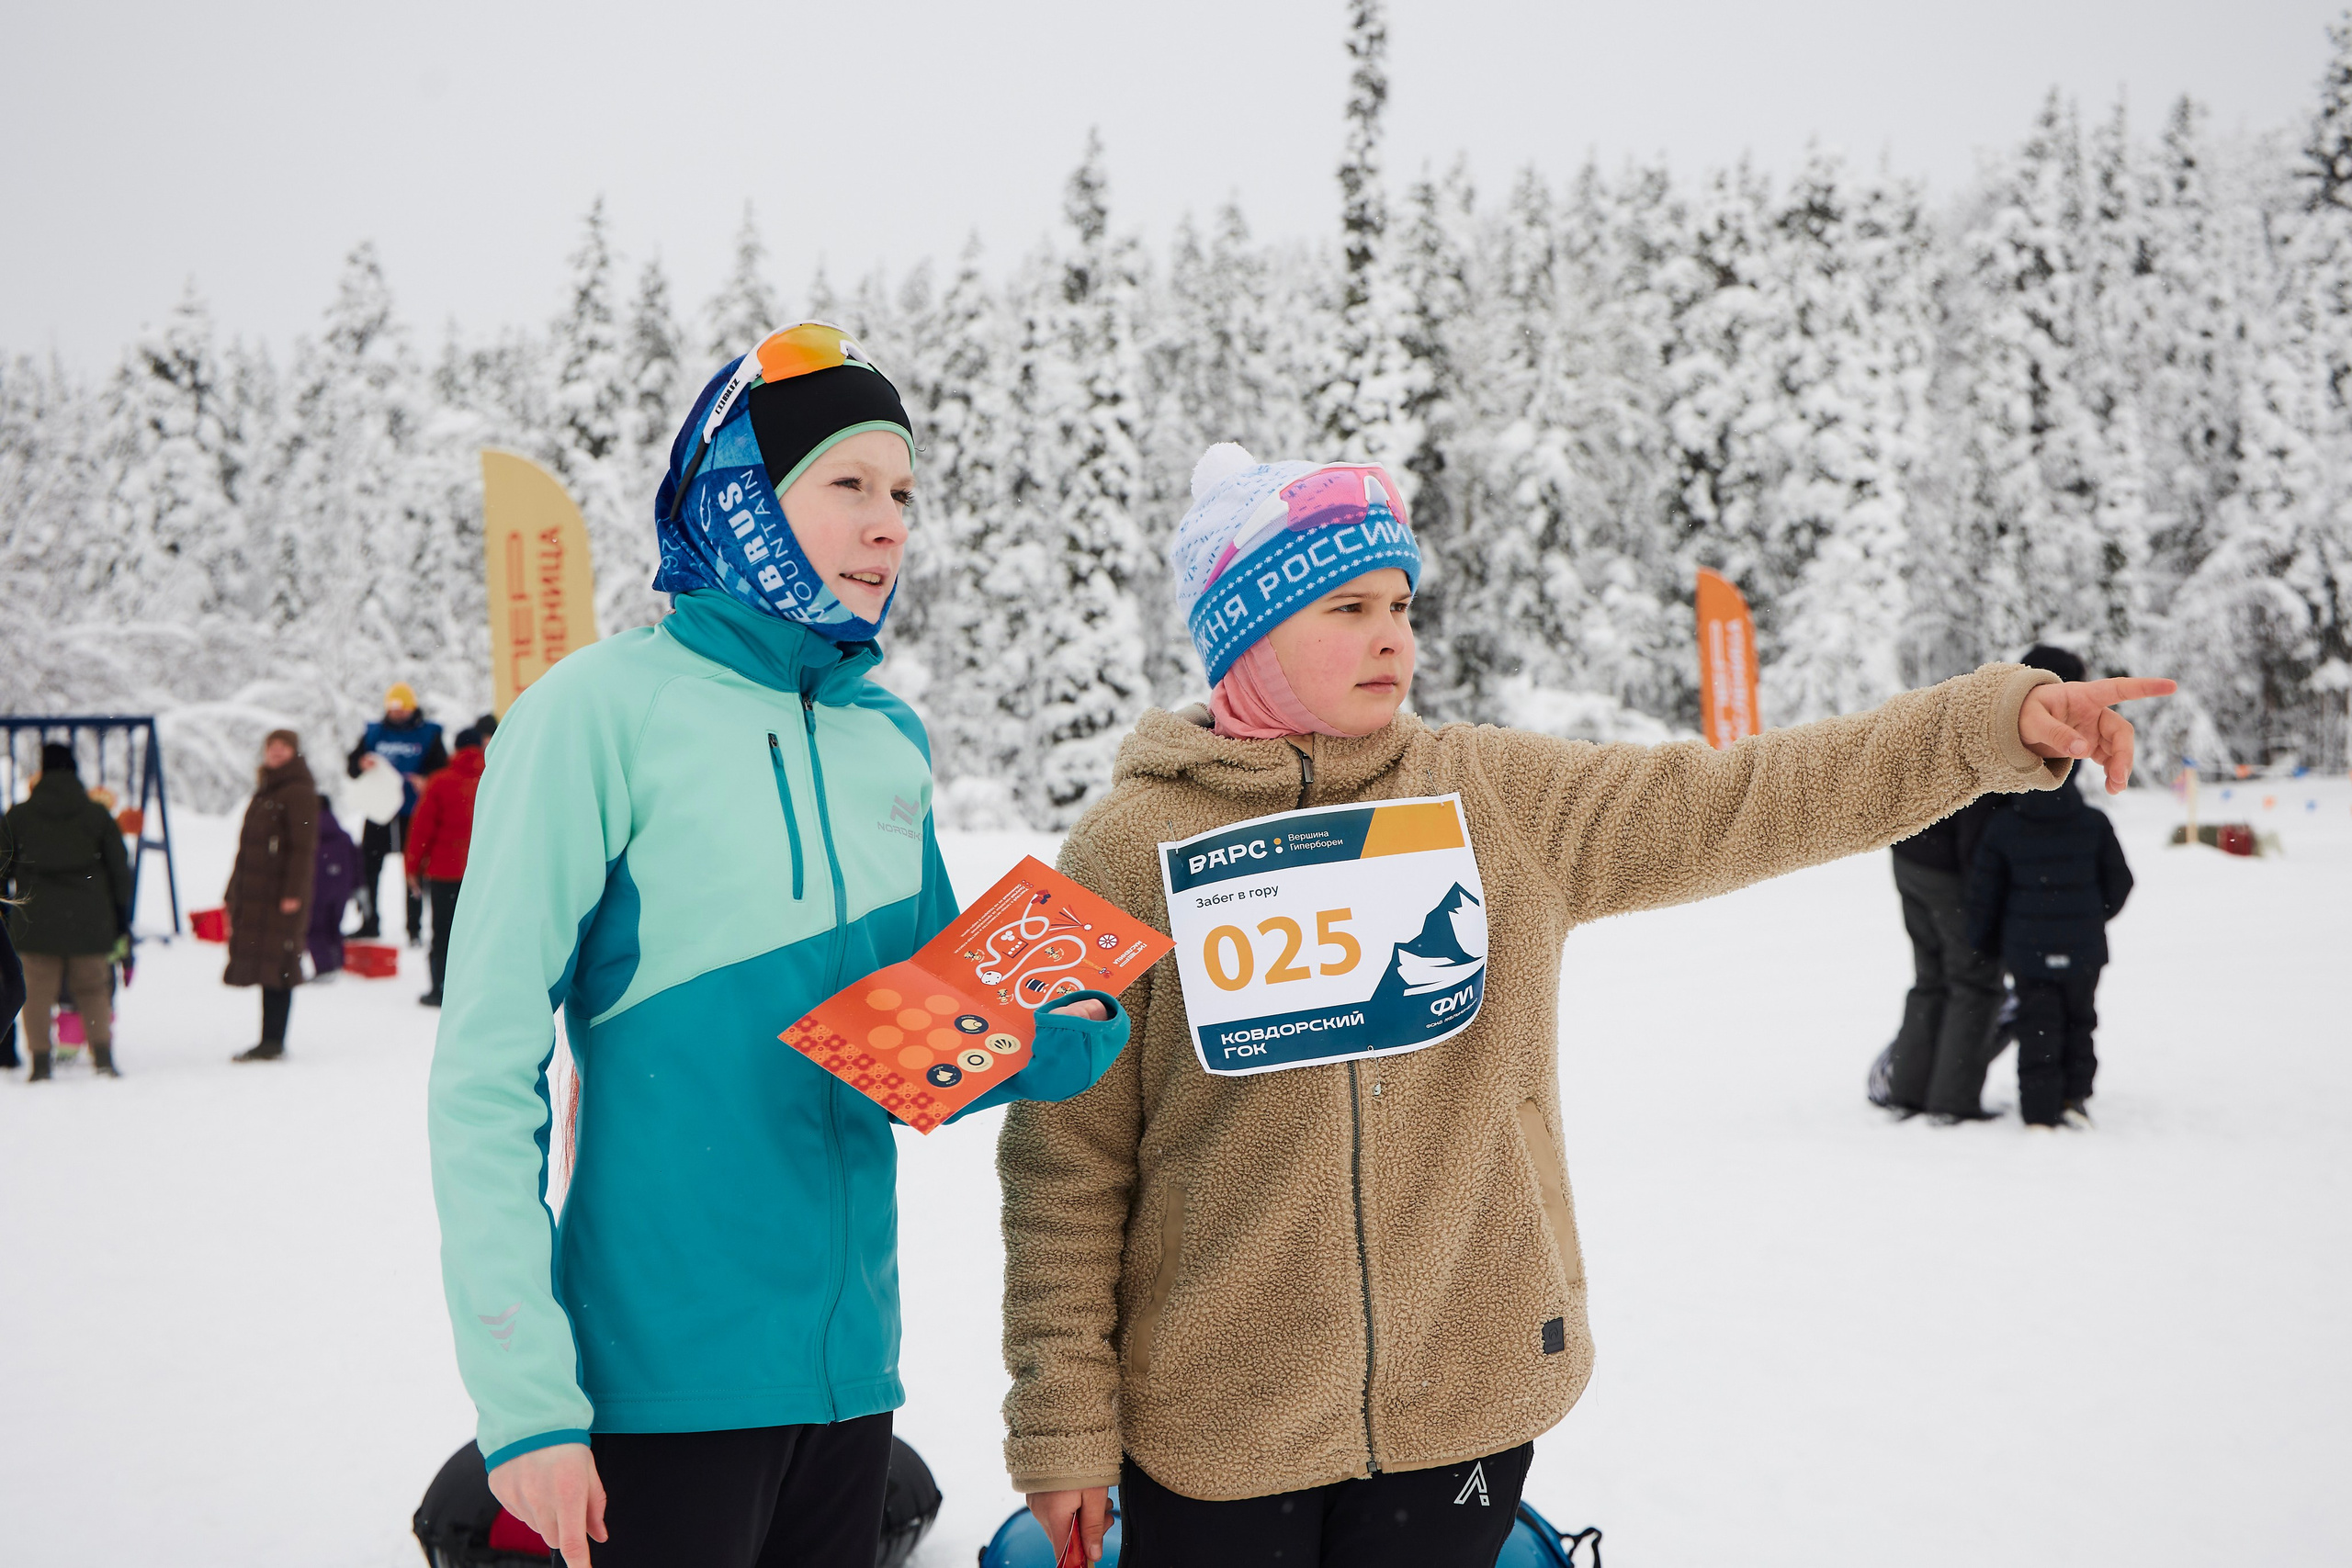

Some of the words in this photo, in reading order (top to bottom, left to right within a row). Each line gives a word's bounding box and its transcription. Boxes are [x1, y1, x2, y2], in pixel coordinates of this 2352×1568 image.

[721, 378, 741, 401] BLIZ
[718, 481, 812, 624] ELBRUS
[741, 468, 830, 623] MOUNTAIN
[1256, 521, 1411, 601] РОССИИ
[876, 821, 922, 842] NORDSKI
[1287, 829, 1329, 842] Вершина
[1289, 838, 1344, 852] Гипербореи
[1195, 893, 1235, 908] Забег
[1238, 890, 1246, 899] в
[1249, 884, 1279, 899] гору
[1202, 907, 1363, 992] 025
[1430, 985, 1474, 1017] ФМ
[1220, 1010, 1365, 1045] КОВДОРСКИЙ
[1223, 1043, 1268, 1059] ГОК
